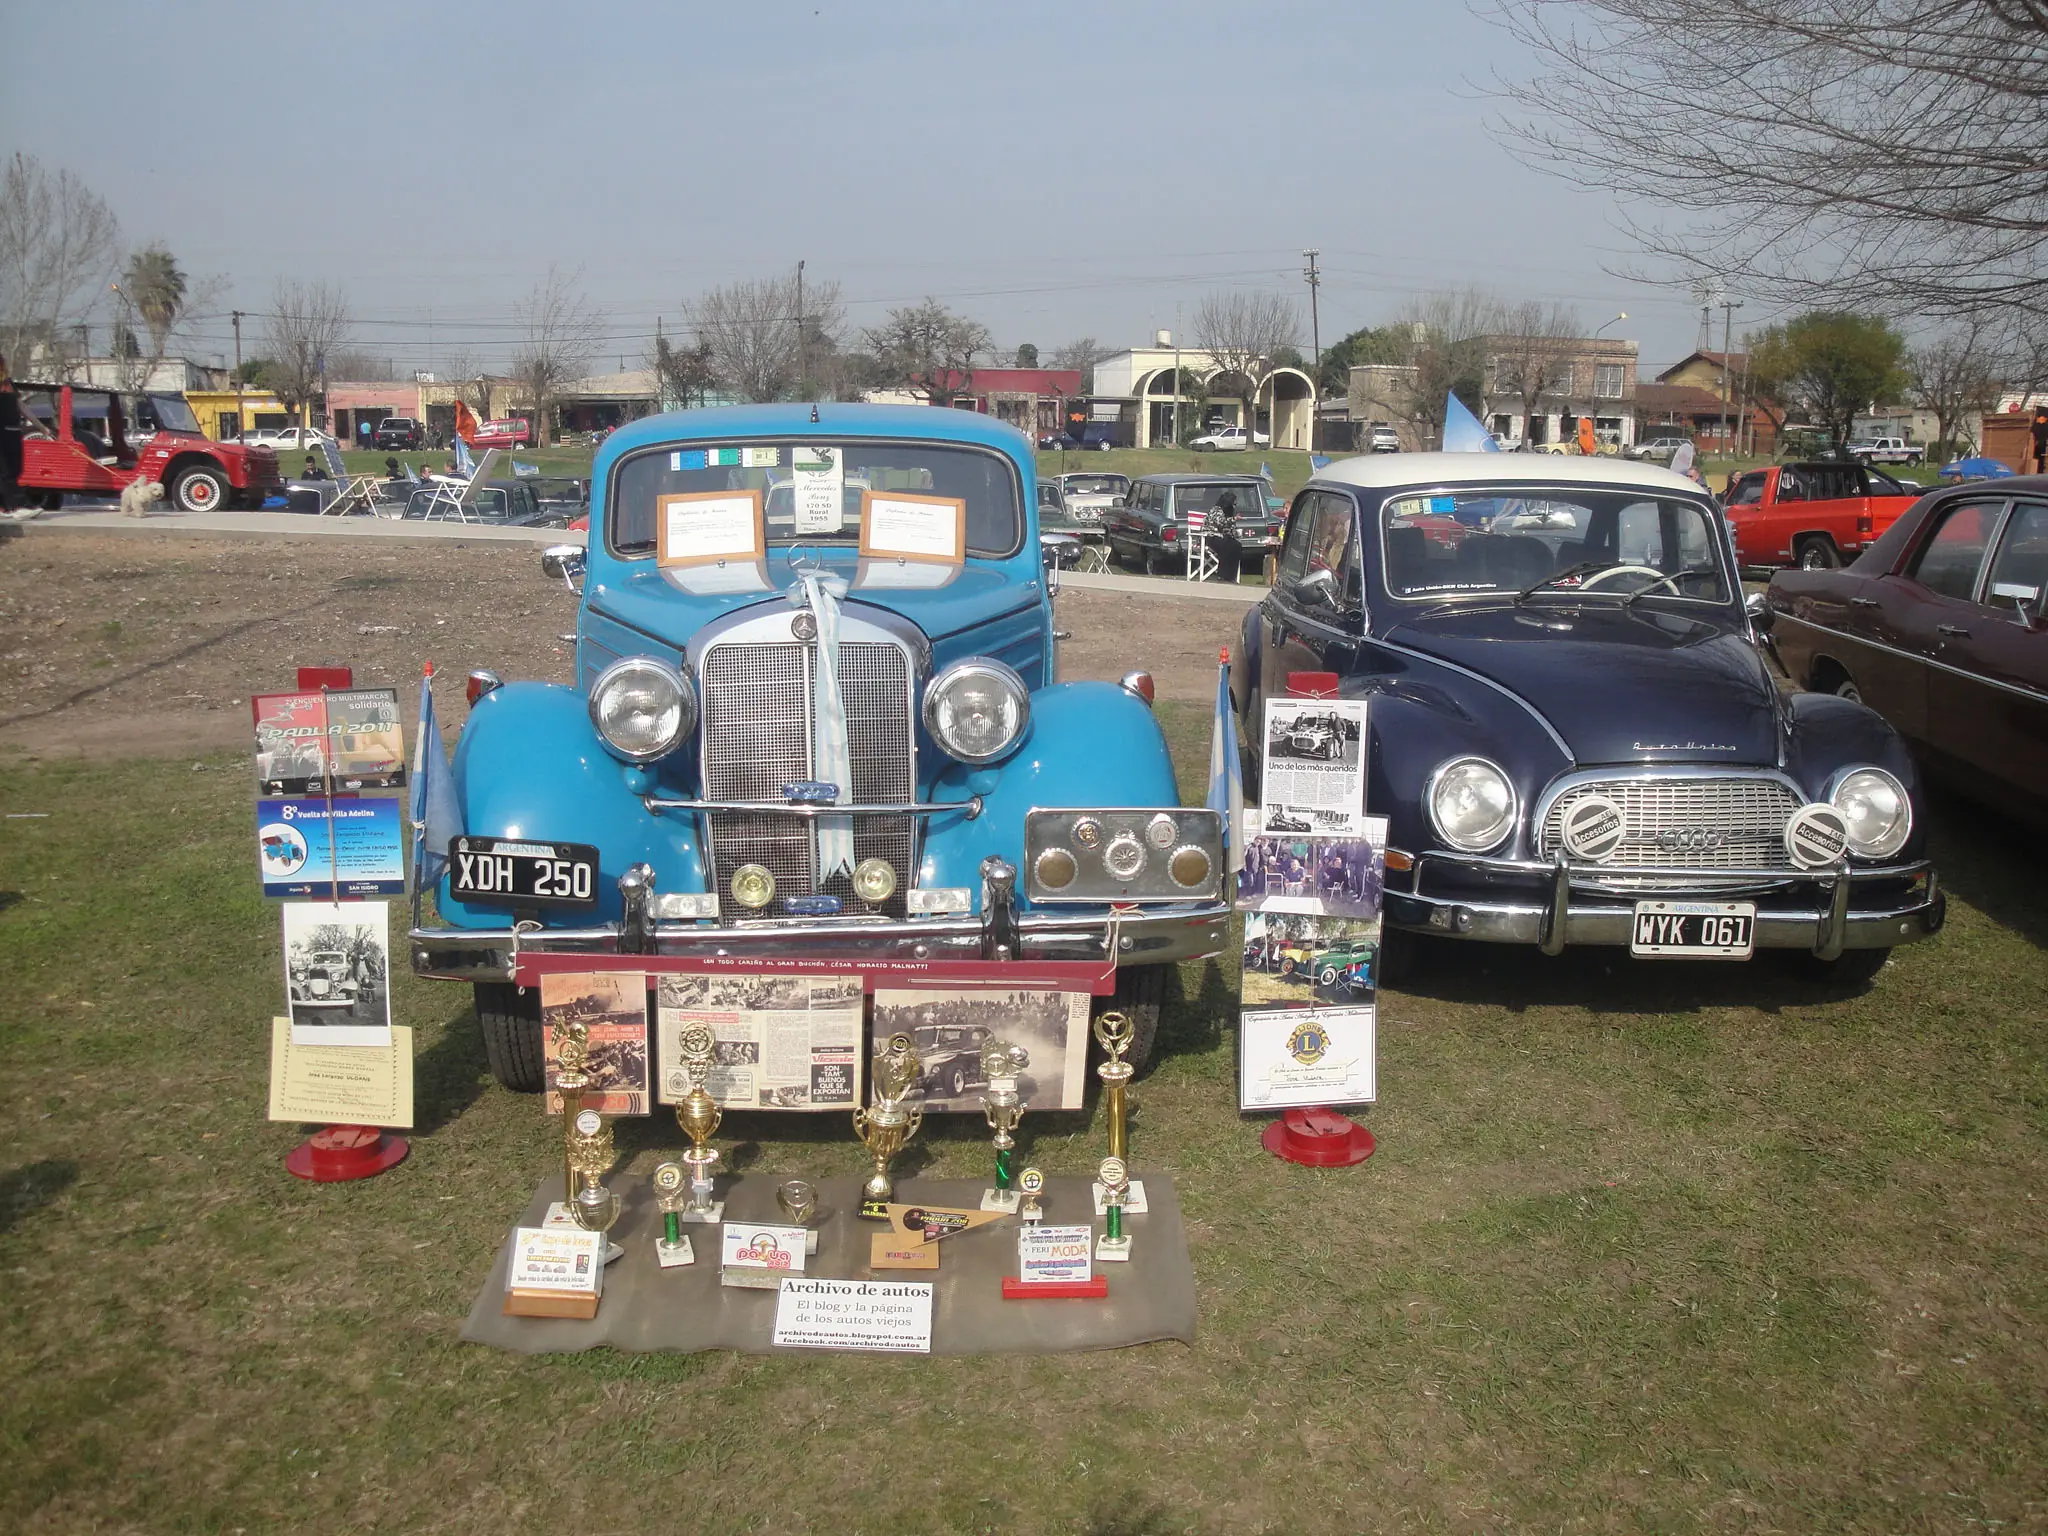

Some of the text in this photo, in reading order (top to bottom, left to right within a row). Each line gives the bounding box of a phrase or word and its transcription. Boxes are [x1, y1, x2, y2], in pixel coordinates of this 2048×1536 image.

[293, 695, 336, 705] ENCUENRO
[338, 694, 389, 702] MULTIMARCAS
[349, 700, 390, 710] solidario
[347, 722, 393, 733] 2011
[1269, 762, 1284, 770] Uno
[1285, 762, 1295, 770] de
[1307, 763, 1323, 772] más
[1324, 764, 1358, 773] queridos
[298, 810, 320, 818] Vuelta
[322, 810, 330, 818] de
[349, 809, 375, 817] Adelina
[1573, 818, 1619, 845] Accesorios
[1797, 825, 1841, 852] Accesorios
[497, 844, 551, 854] ARGENTINA
[458, 854, 591, 898] XDH 250
[1672, 904, 1719, 913] ARGENTINA
[1639, 915, 1747, 946] WYK 061
[1298, 1024, 1321, 1033] LIONS
[1303, 1035, 1315, 1051] L
[1052, 1244, 1088, 1257] MODA
[782, 1281, 930, 1298] Archivo de autos
[797, 1300, 913, 1315] El blog y la página
[796, 1313, 912, 1328] de los autos viejos
[778, 1329, 927, 1341] archivodeautos.blogspot.com.ar
[783, 1337, 921, 1348] facebook.com/archivodeautos
